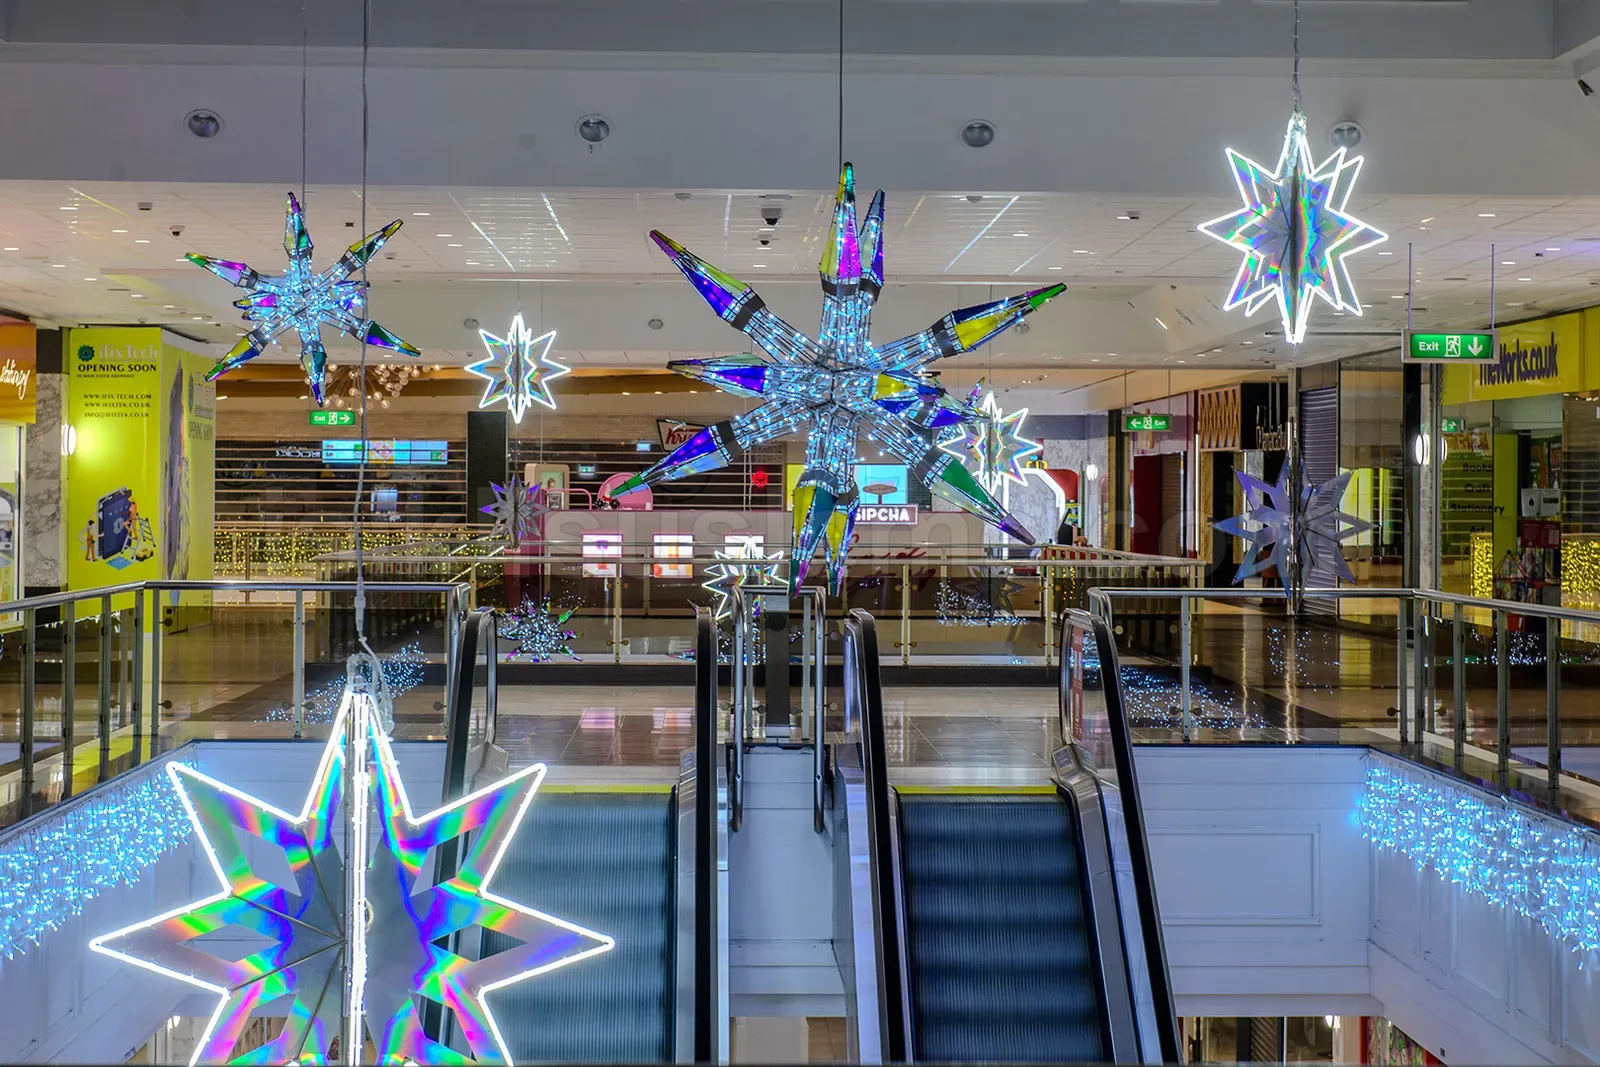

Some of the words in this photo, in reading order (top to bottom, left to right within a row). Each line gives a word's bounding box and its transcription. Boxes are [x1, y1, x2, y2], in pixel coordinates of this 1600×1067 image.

[1418, 341, 1440, 351] Exit
[78, 363, 125, 372] OPENING
[127, 363, 157, 372] SOON
[1462, 463, 1492, 472] Books
[1464, 483, 1490, 493] Craft
